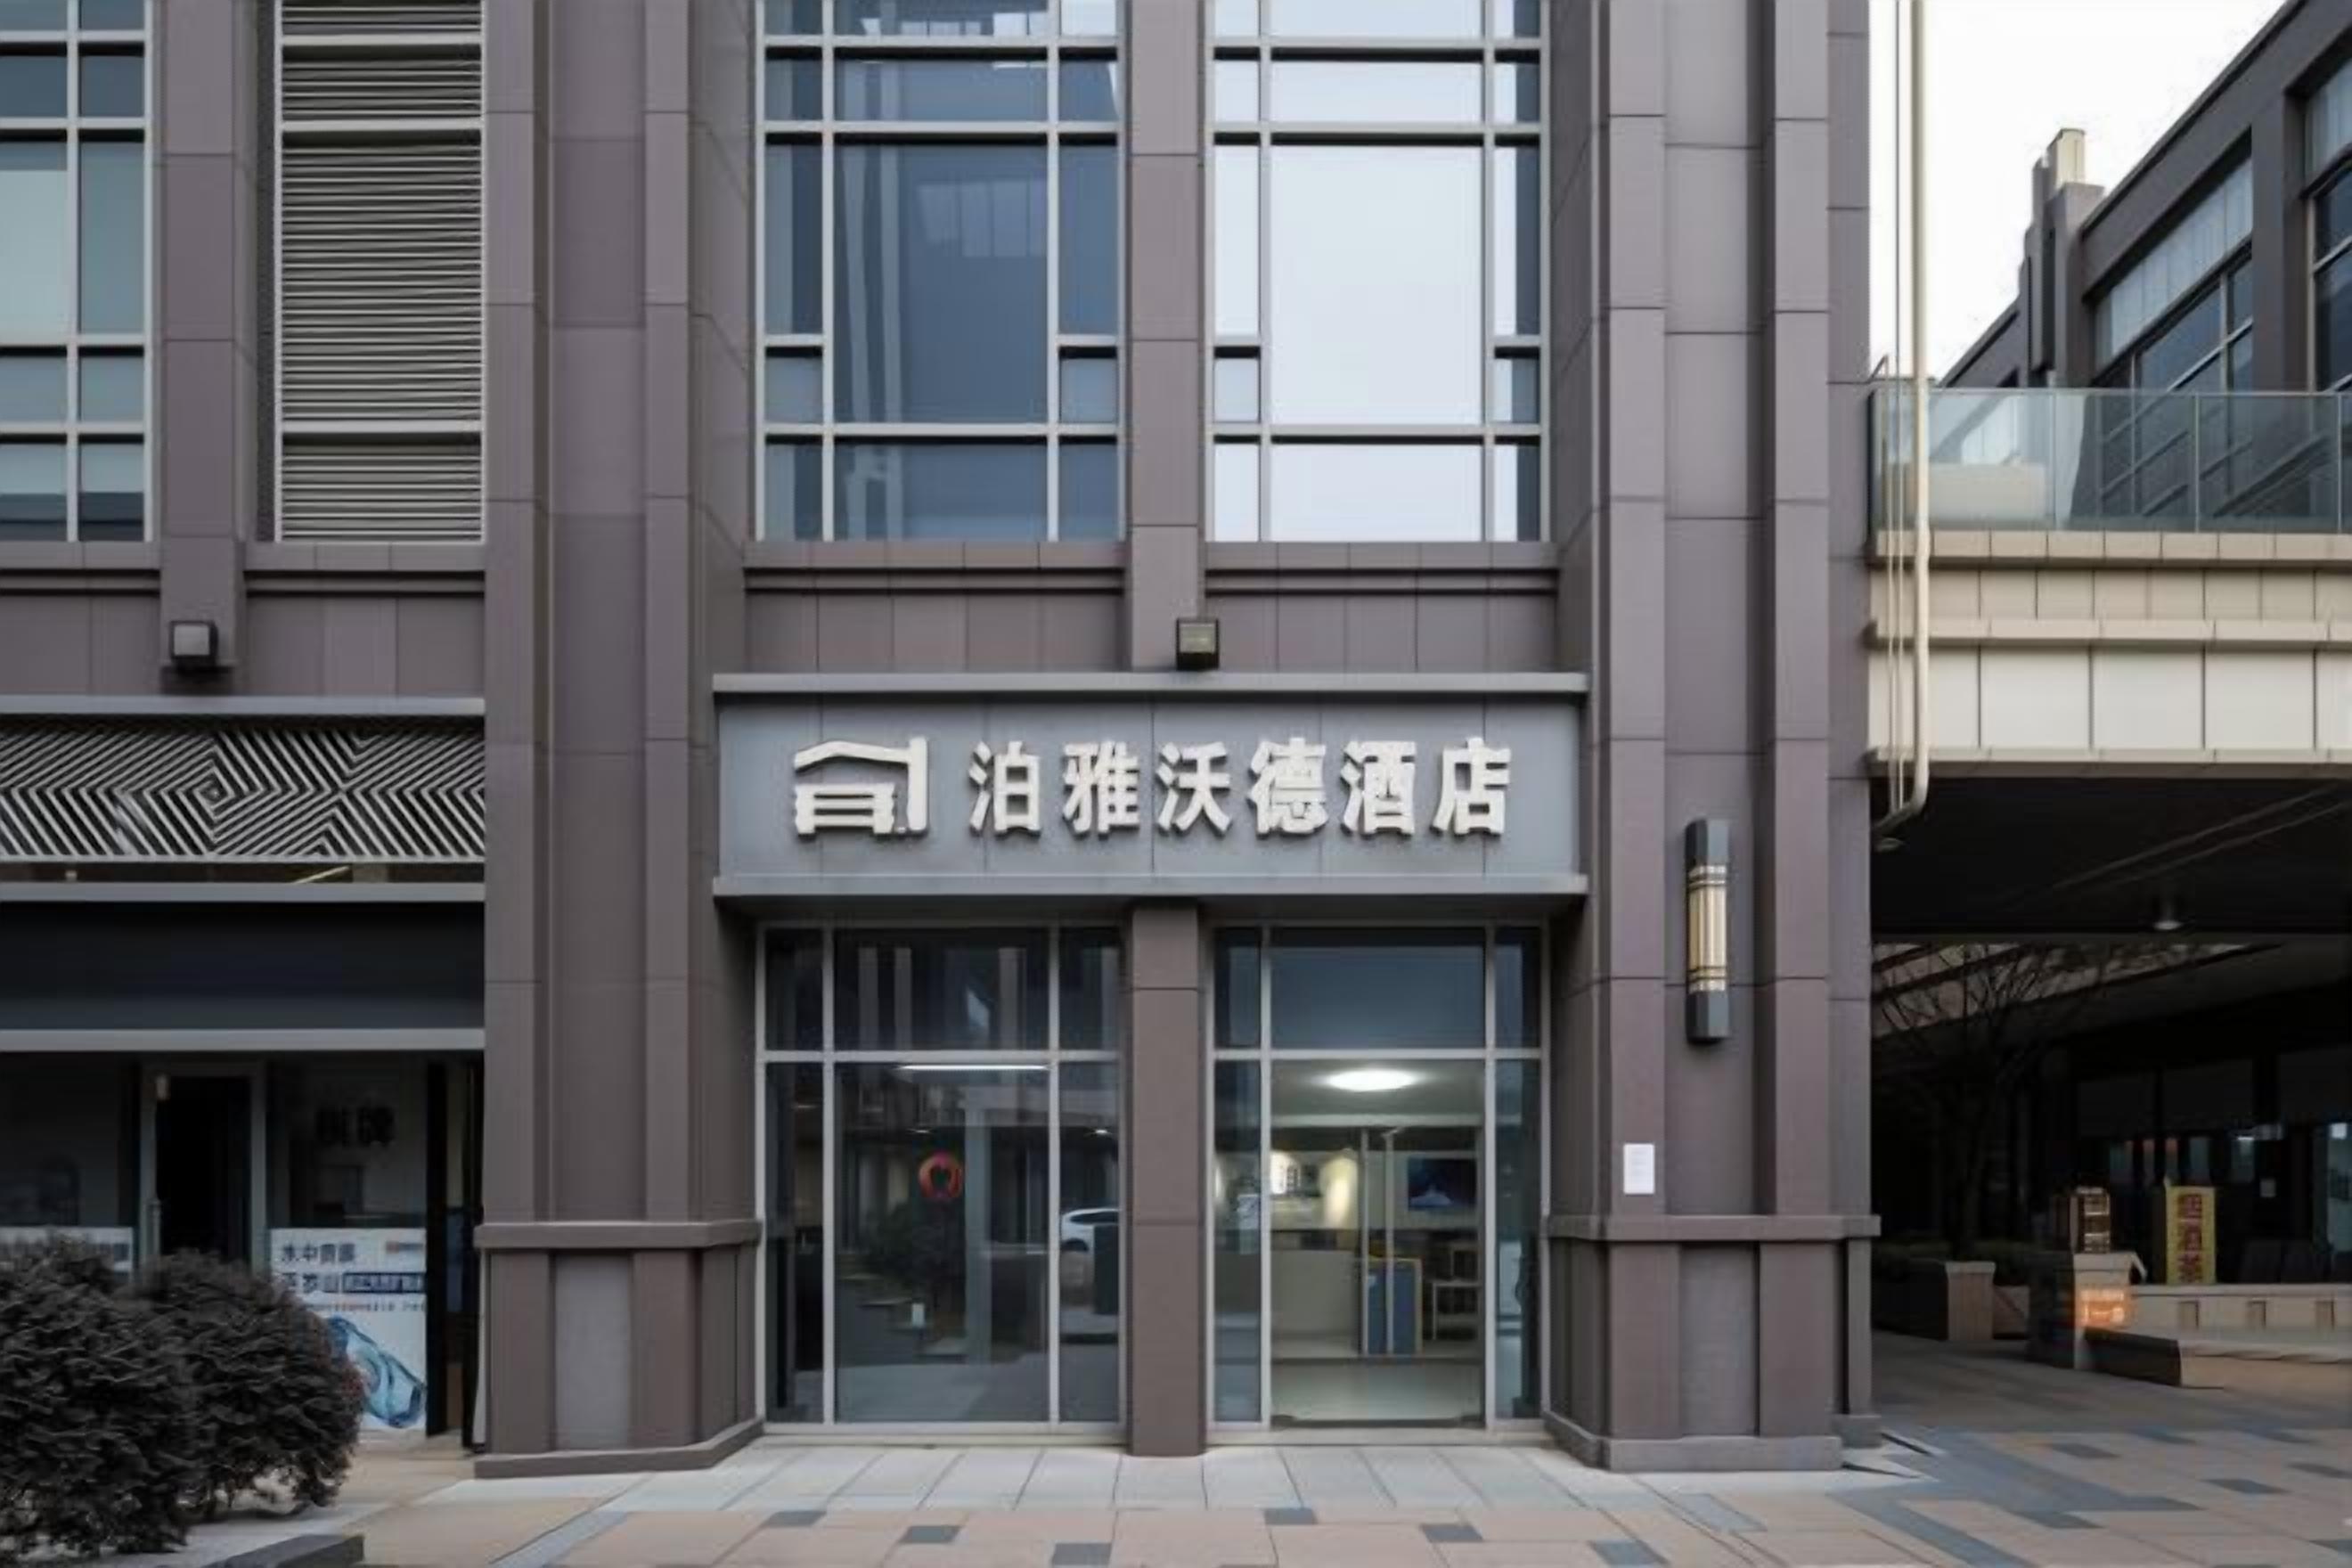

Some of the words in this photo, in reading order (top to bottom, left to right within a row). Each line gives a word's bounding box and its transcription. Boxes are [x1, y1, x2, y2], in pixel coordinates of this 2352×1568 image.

[968, 736, 1511, 837] 泊雅沃德酒店
